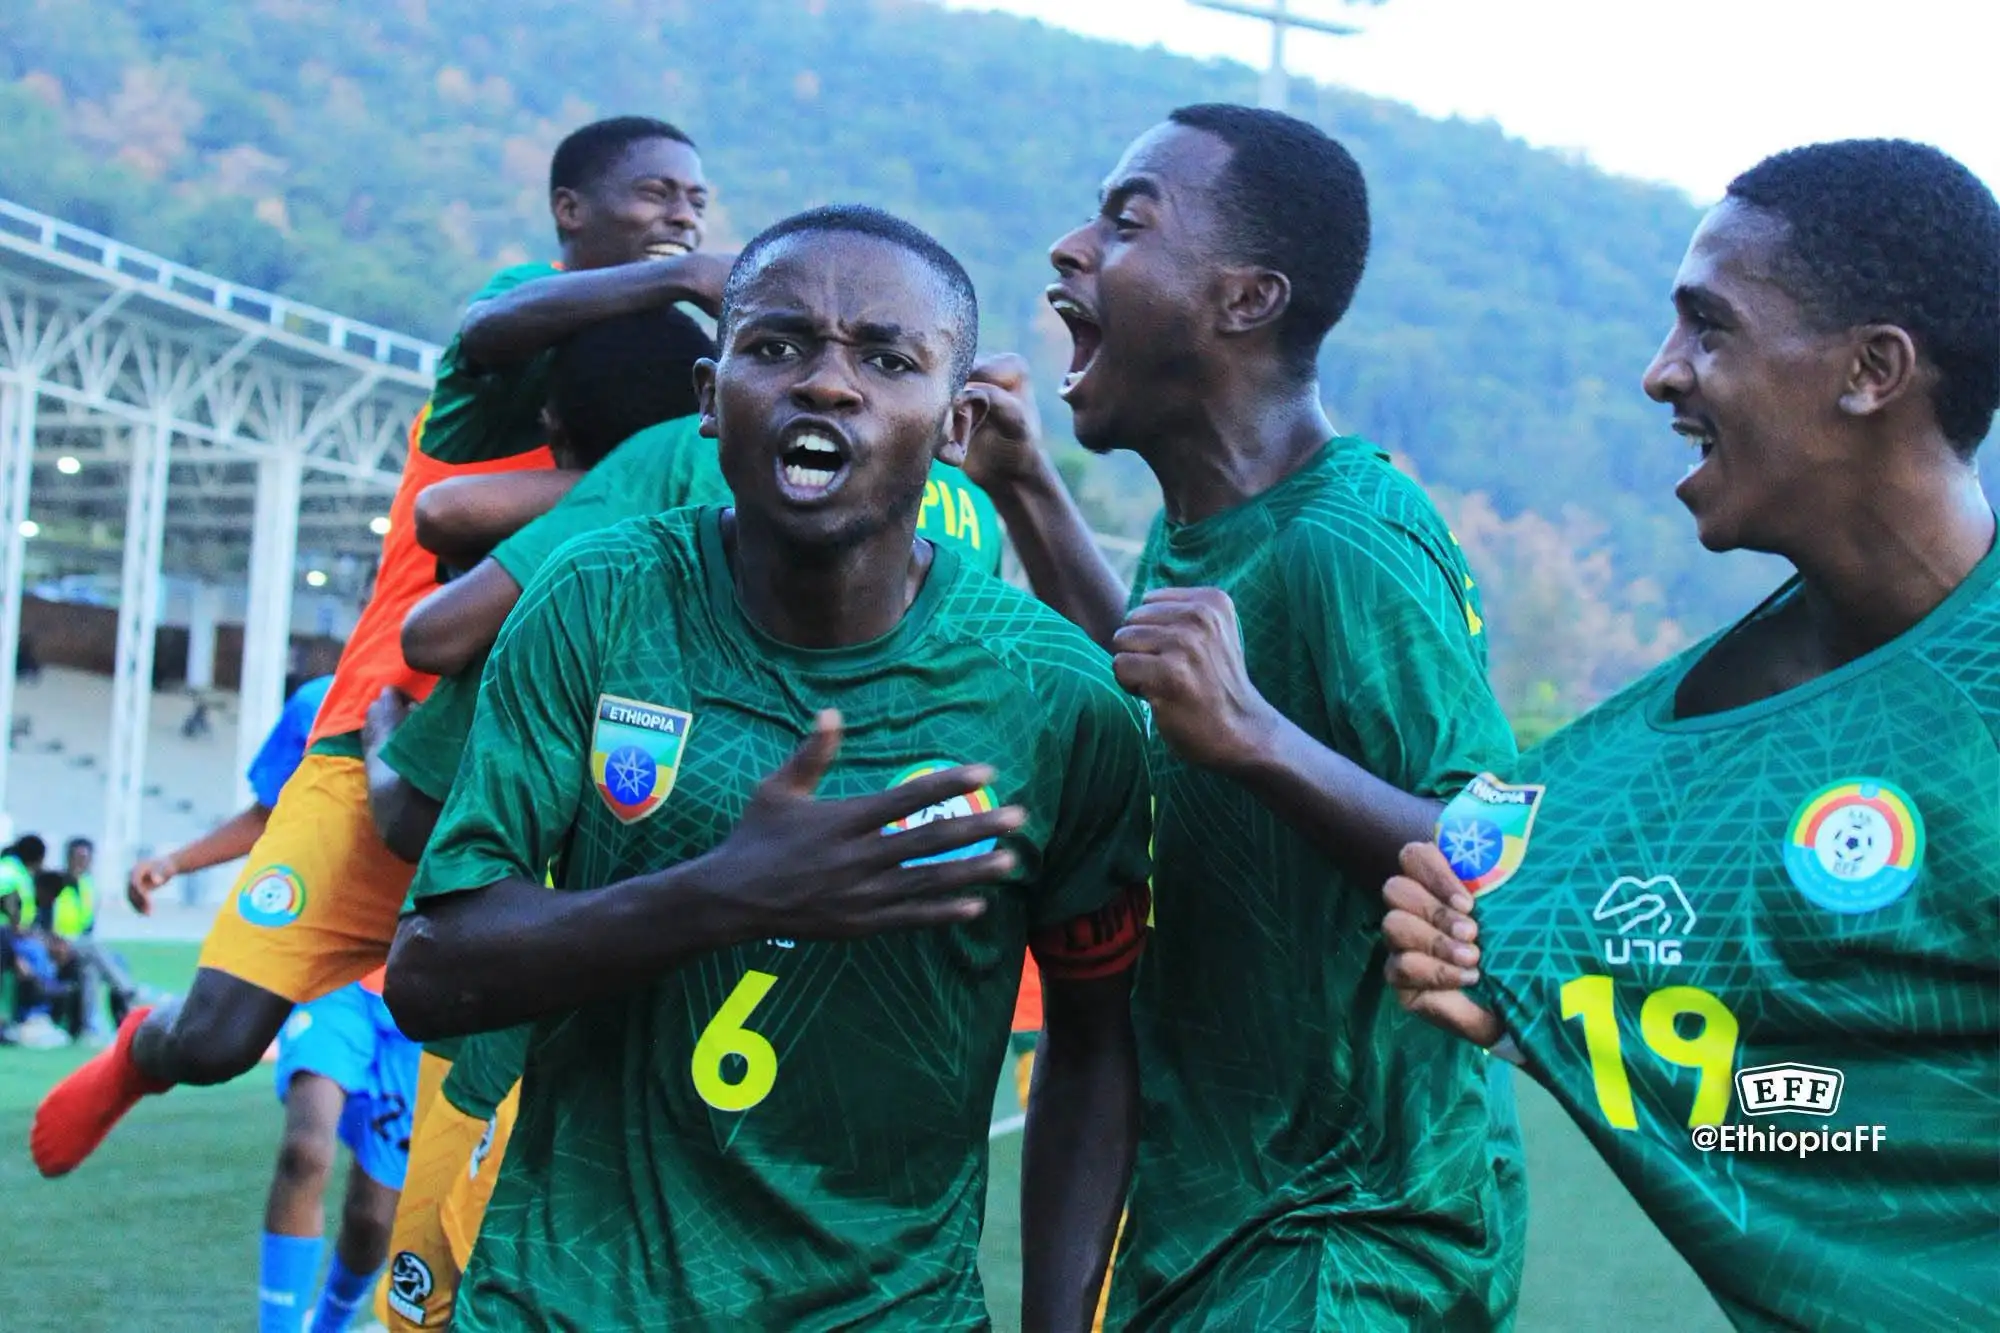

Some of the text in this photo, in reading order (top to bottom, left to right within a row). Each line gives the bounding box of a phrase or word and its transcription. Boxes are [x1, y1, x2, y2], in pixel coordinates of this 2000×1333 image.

[608, 706, 675, 733] ETHIOPIA
[692, 969, 778, 1111] 6
[1560, 975, 1739, 1131] 19
